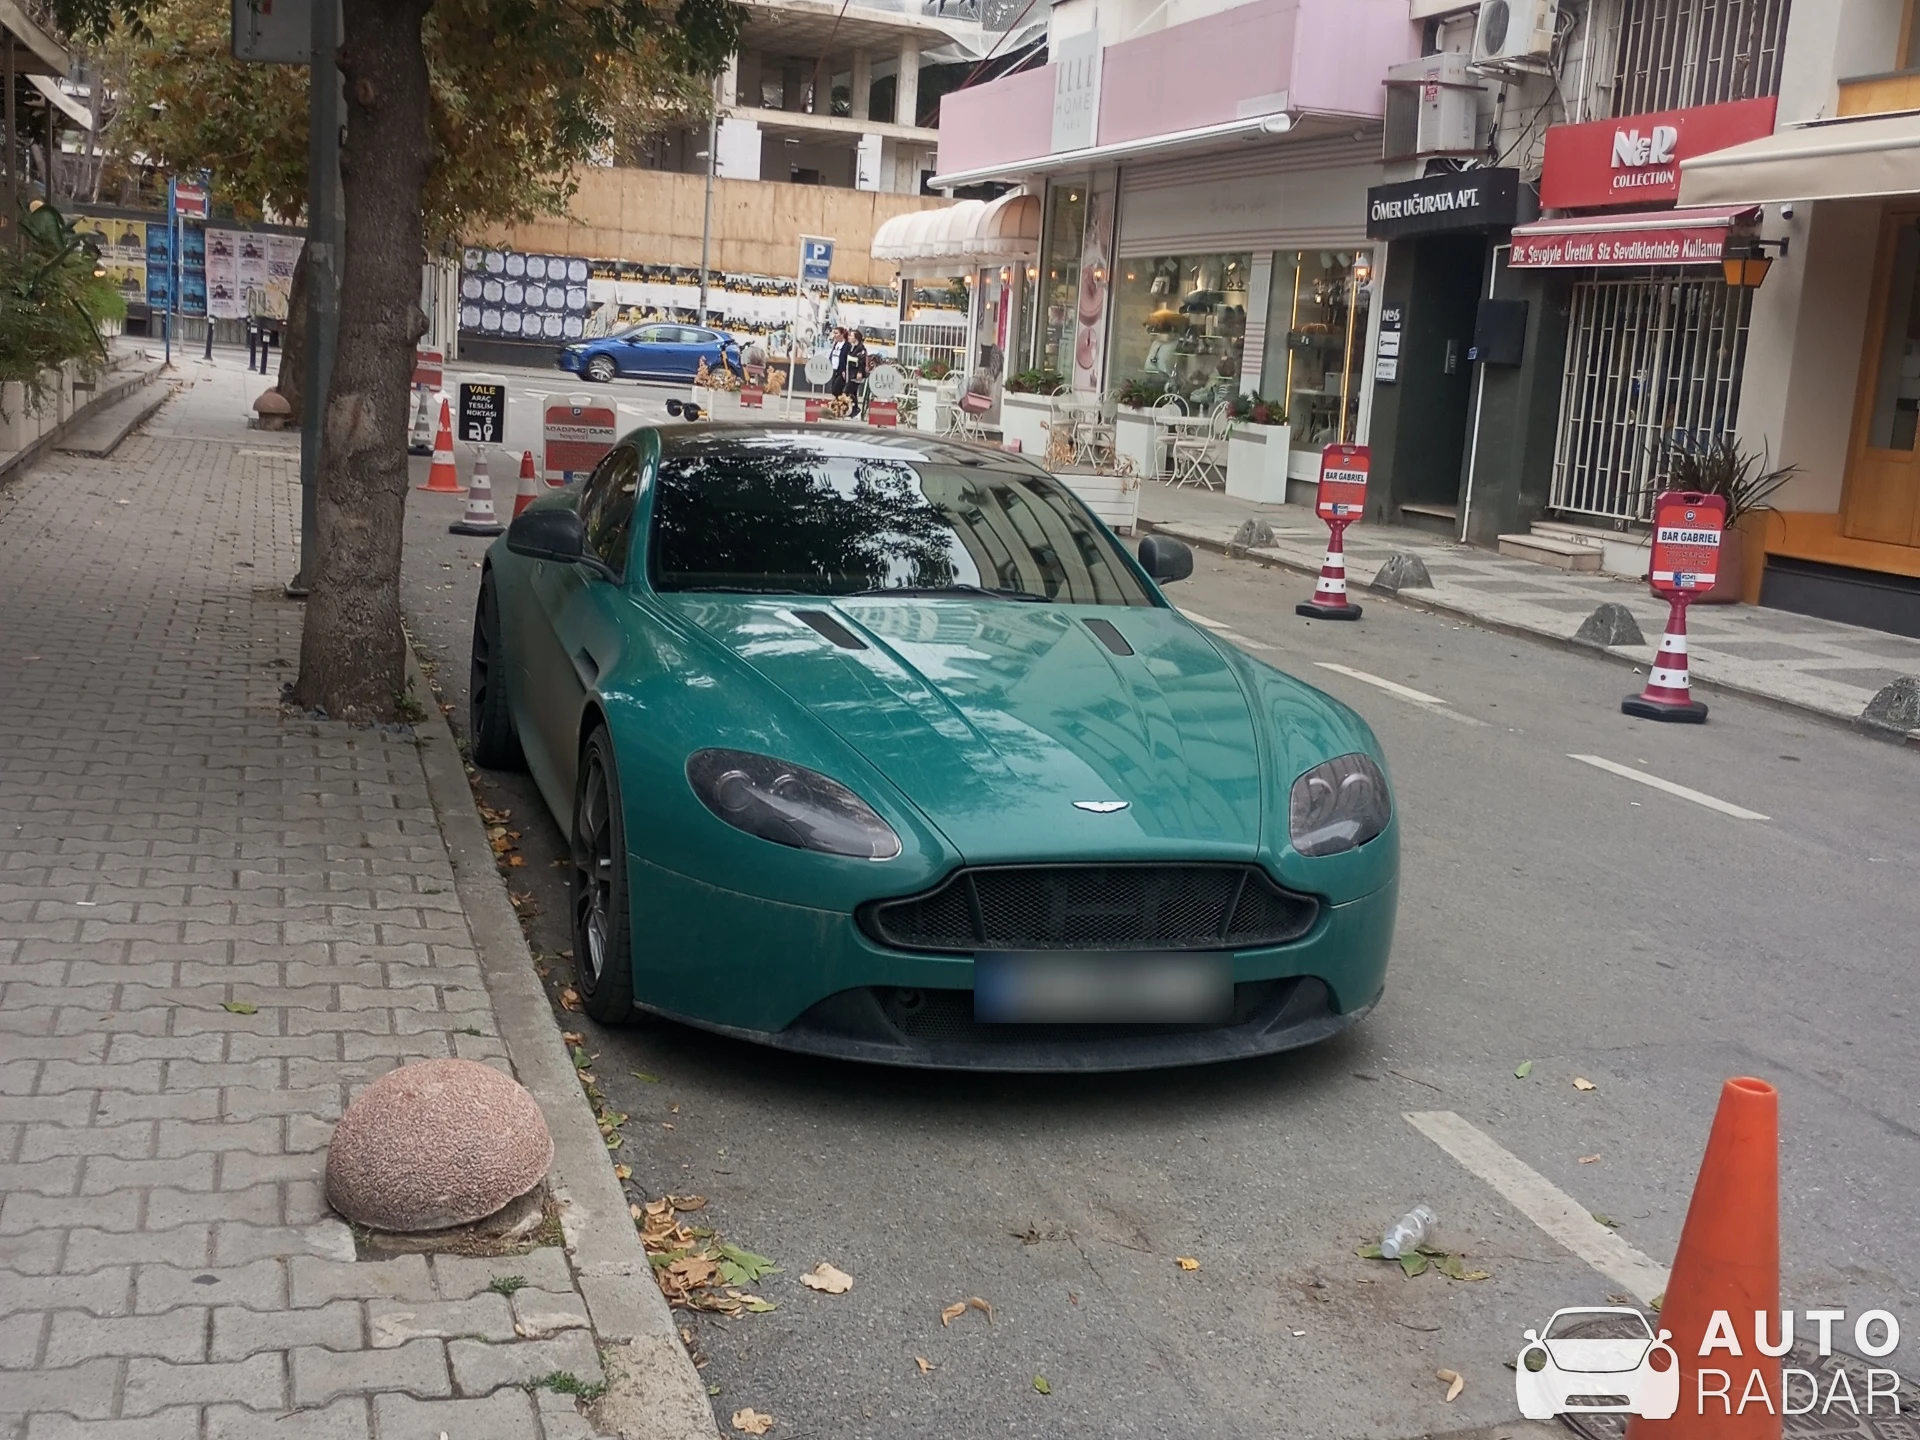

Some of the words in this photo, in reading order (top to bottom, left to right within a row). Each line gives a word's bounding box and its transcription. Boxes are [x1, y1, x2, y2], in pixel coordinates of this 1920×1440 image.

[1056, 92, 1091, 115] HOME
[1611, 126, 1677, 168] N&R
[1613, 170, 1675, 188] COLLECTION
[1371, 200, 1402, 221] ÖMER
[1403, 193, 1455, 217] UĞURATA
[1455, 188, 1480, 209] APT.
[813, 244, 826, 259] P
[1528, 244, 1562, 265] Sevgiyle
[1564, 240, 1594, 261] Ürettik
[1597, 242, 1611, 260] Siz
[1613, 239, 1679, 260] Sevdiklerinizle
[1682, 239, 1723, 258] Kullanın
[469, 385, 496, 395] VALE
[471, 395, 492, 403] ARAÇ
[466, 409, 497, 417] NOKTASI
[1325, 472, 1338, 480] BAR
[1338, 473, 1364, 482] GABRIEL
[1661, 531, 1678, 541] BAR
[1681, 532, 1718, 543] GABRIEL
